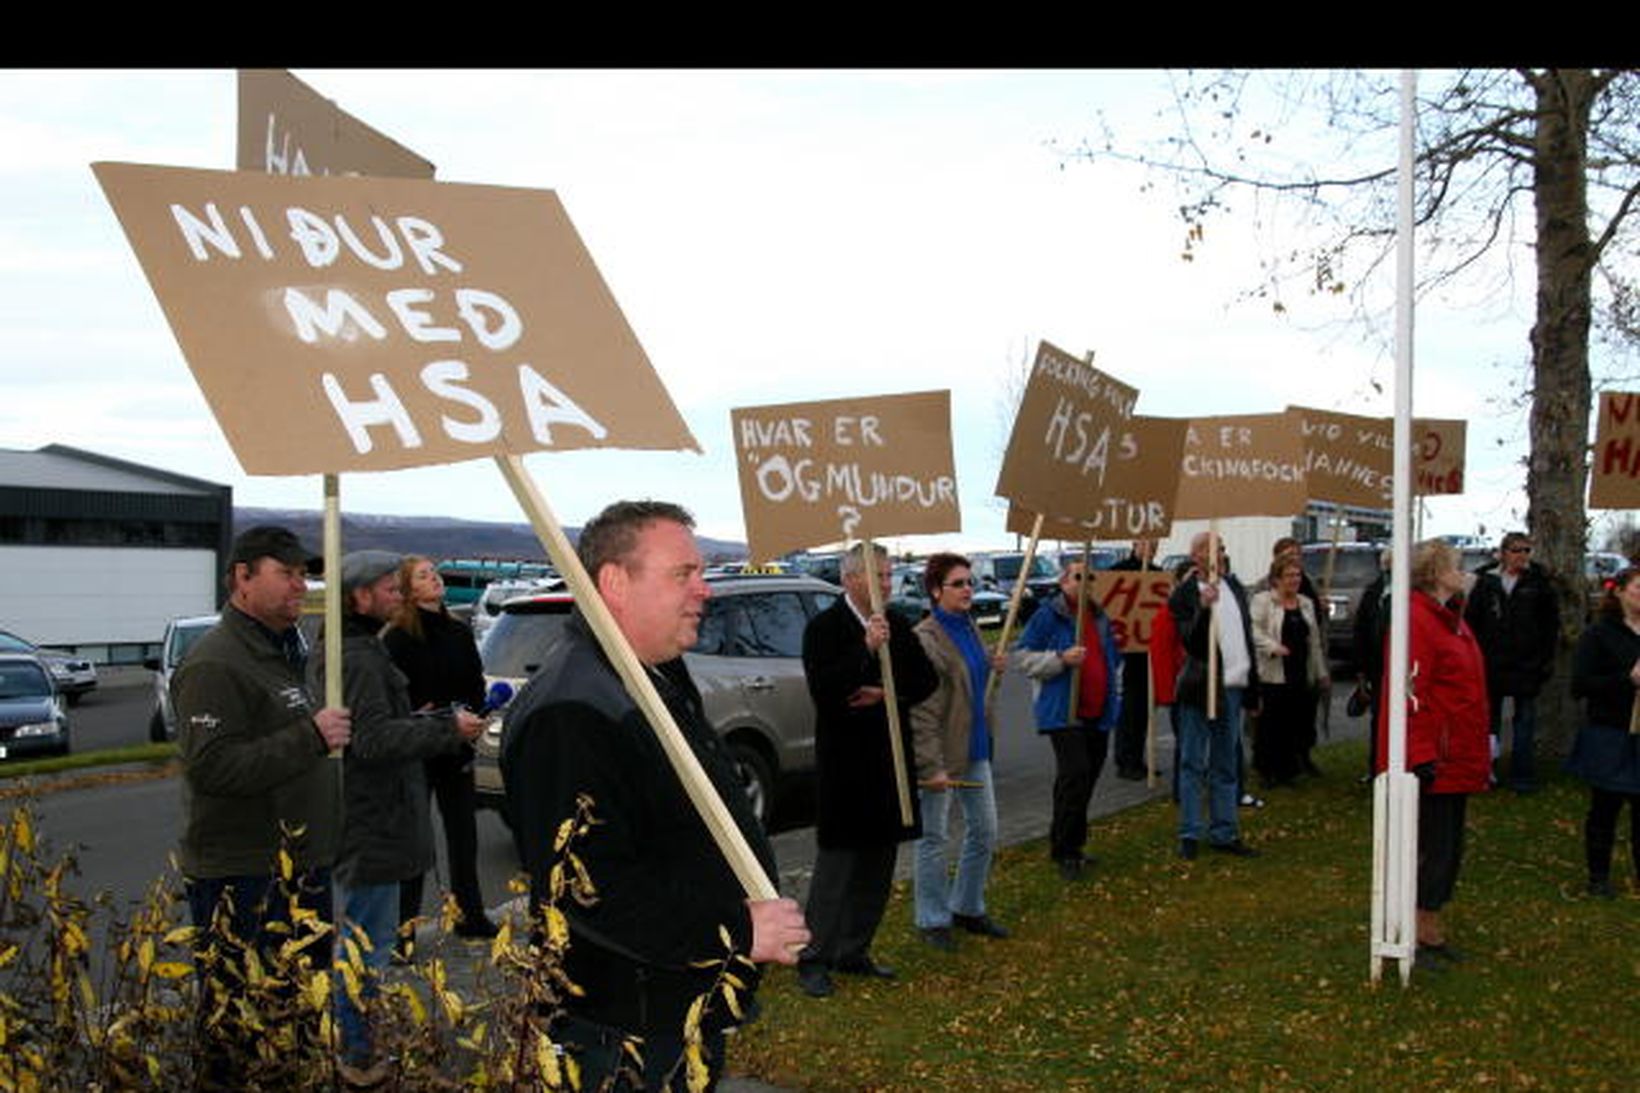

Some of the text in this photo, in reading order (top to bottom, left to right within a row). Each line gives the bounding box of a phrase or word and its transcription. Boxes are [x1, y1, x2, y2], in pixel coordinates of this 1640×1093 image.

[322, 361, 608, 454] HSA
[741, 416, 883, 449] HVAR ER
[1045, 396, 1110, 488] HSA
